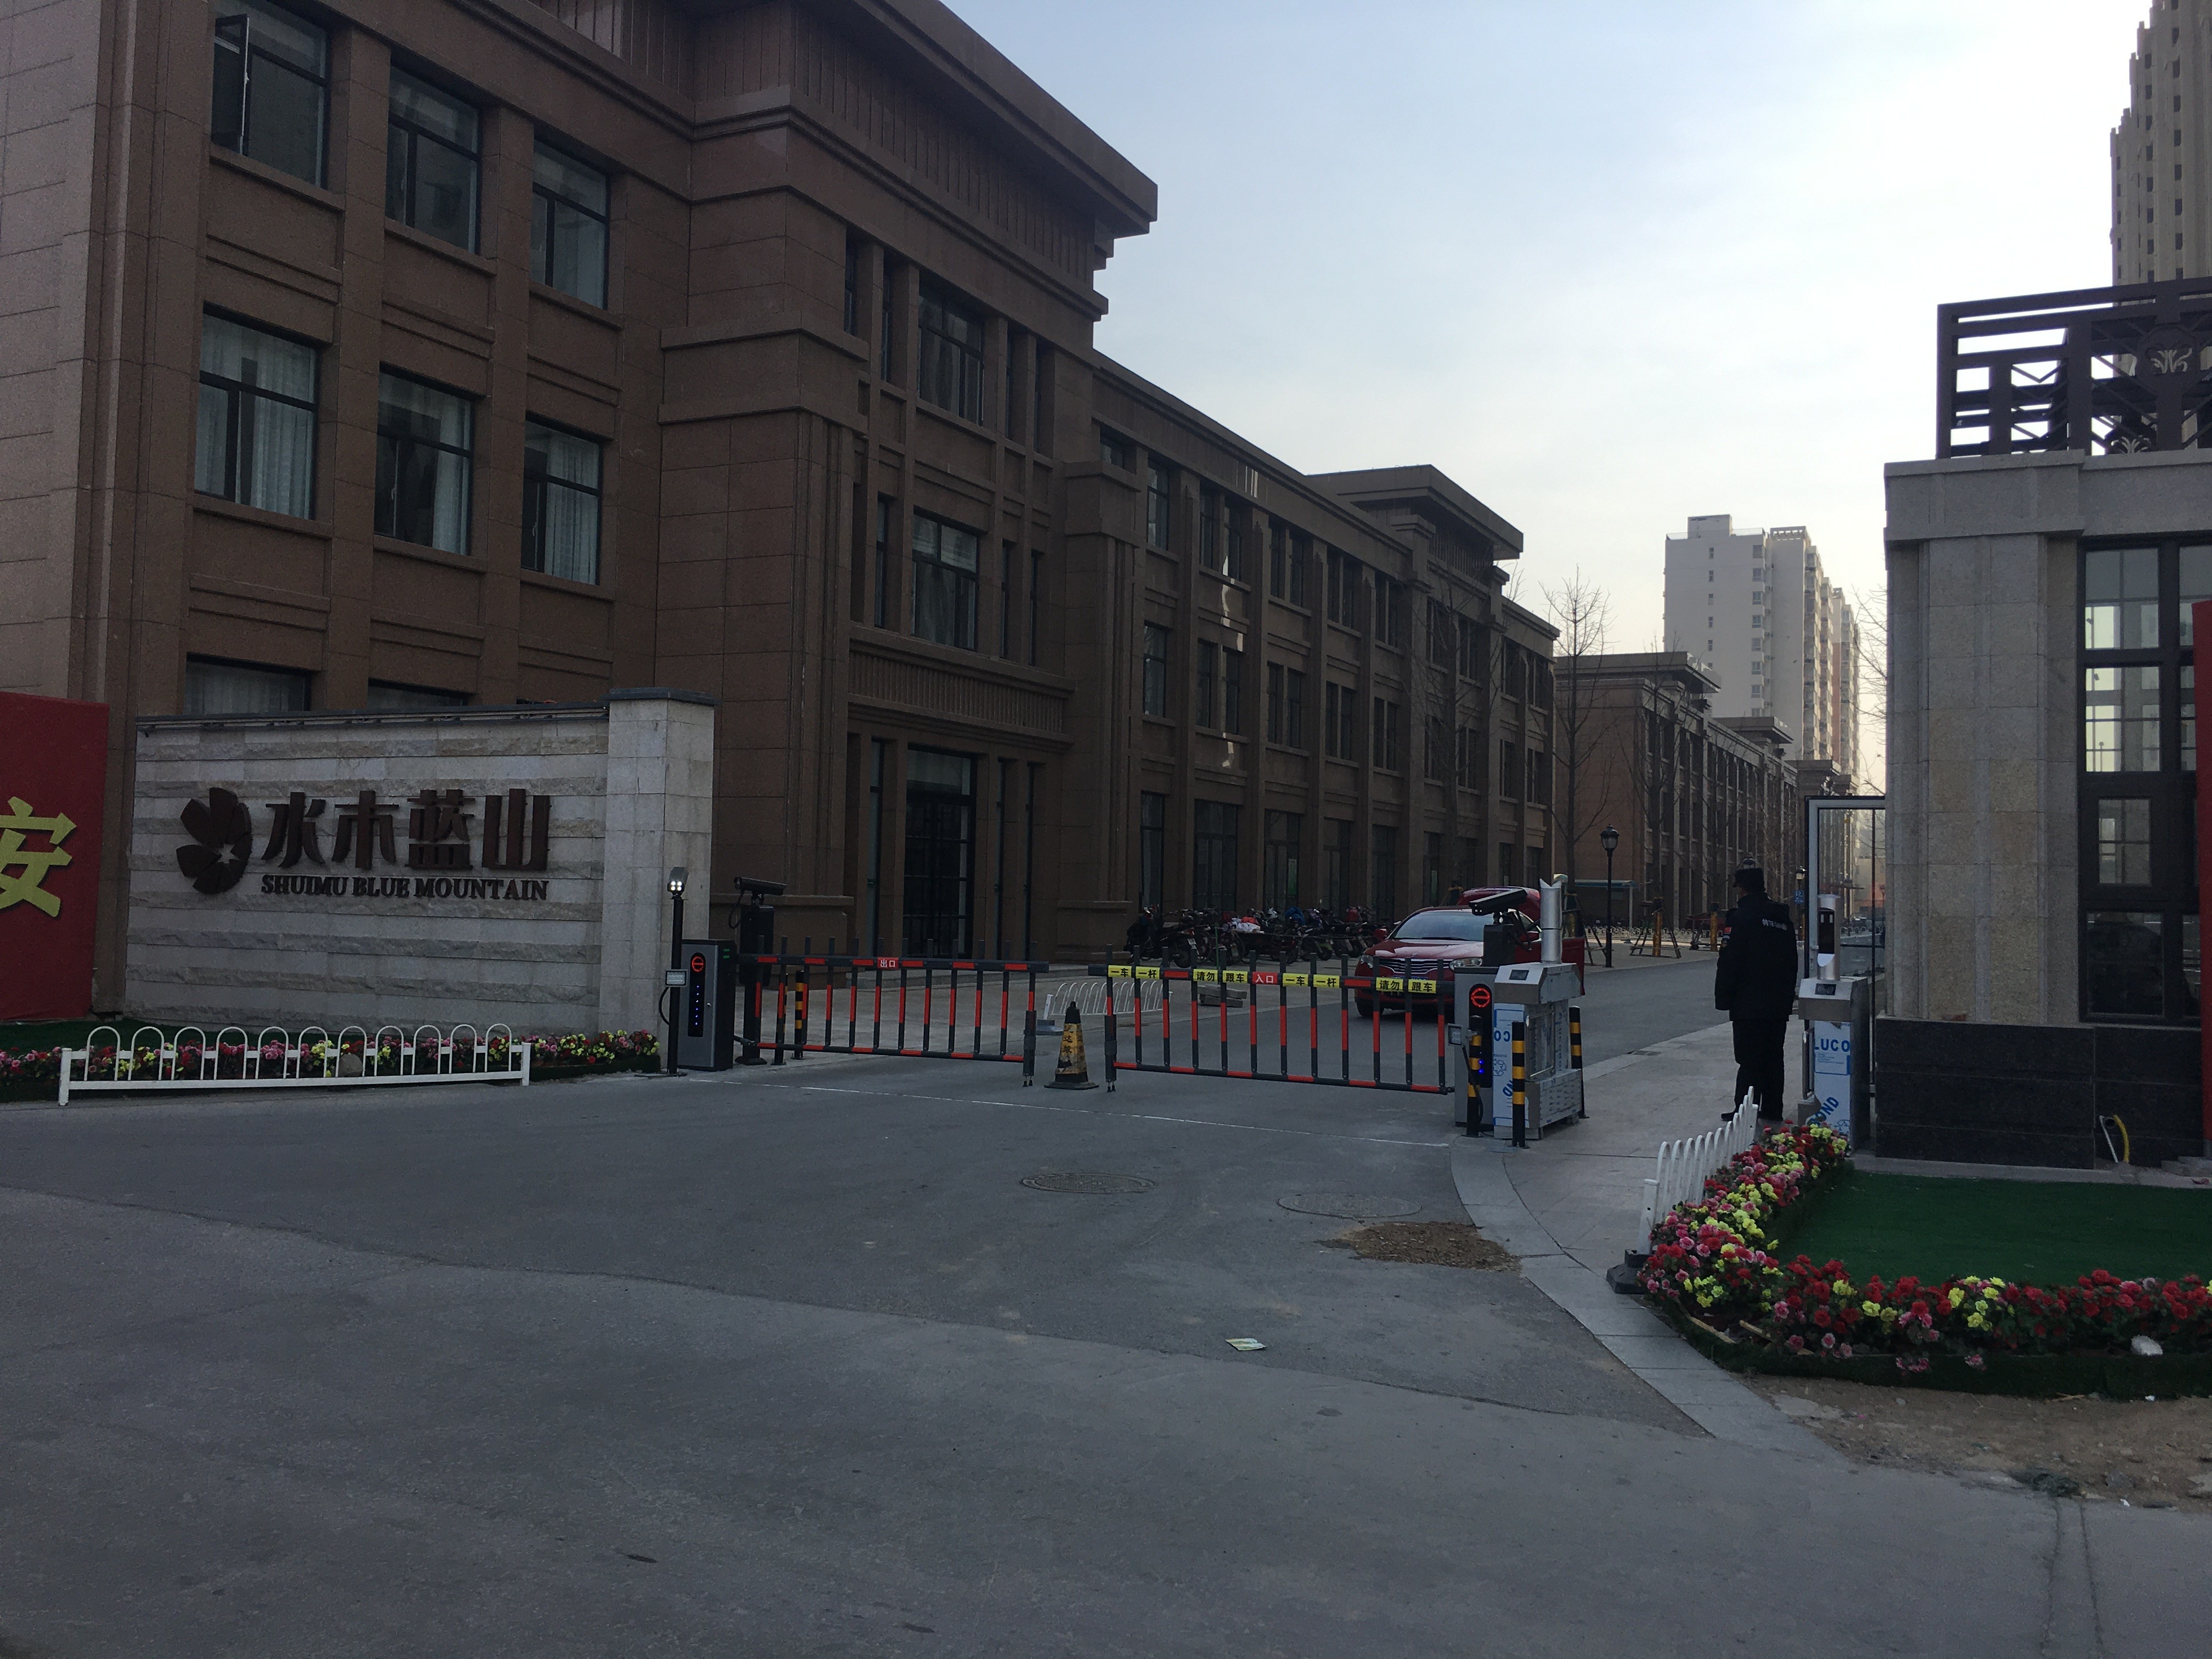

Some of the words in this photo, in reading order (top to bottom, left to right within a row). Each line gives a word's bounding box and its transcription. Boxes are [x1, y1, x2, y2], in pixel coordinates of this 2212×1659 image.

[261, 788, 551, 871] 水木蓝山
[0, 796, 77, 918] 安
[261, 874, 349, 897] SHUIMU
[352, 877, 410, 898] BLUE
[413, 878, 549, 901] MOUNTAIN
[880, 958, 895, 968] 出口
[1111, 967, 1129, 978] 一车
[1138, 969, 1157, 979] 一杆
[1197, 971, 1215, 981] 请勿
[1226, 973, 1245, 983] 跟车
[1255, 974, 1274, 984] 入口
[1285, 975, 1305, 985] 一车
[1316, 977, 1337, 988] 一杆
[1379, 980, 1400, 990] 请勿
[1412, 981, 1433, 992] 跟车
